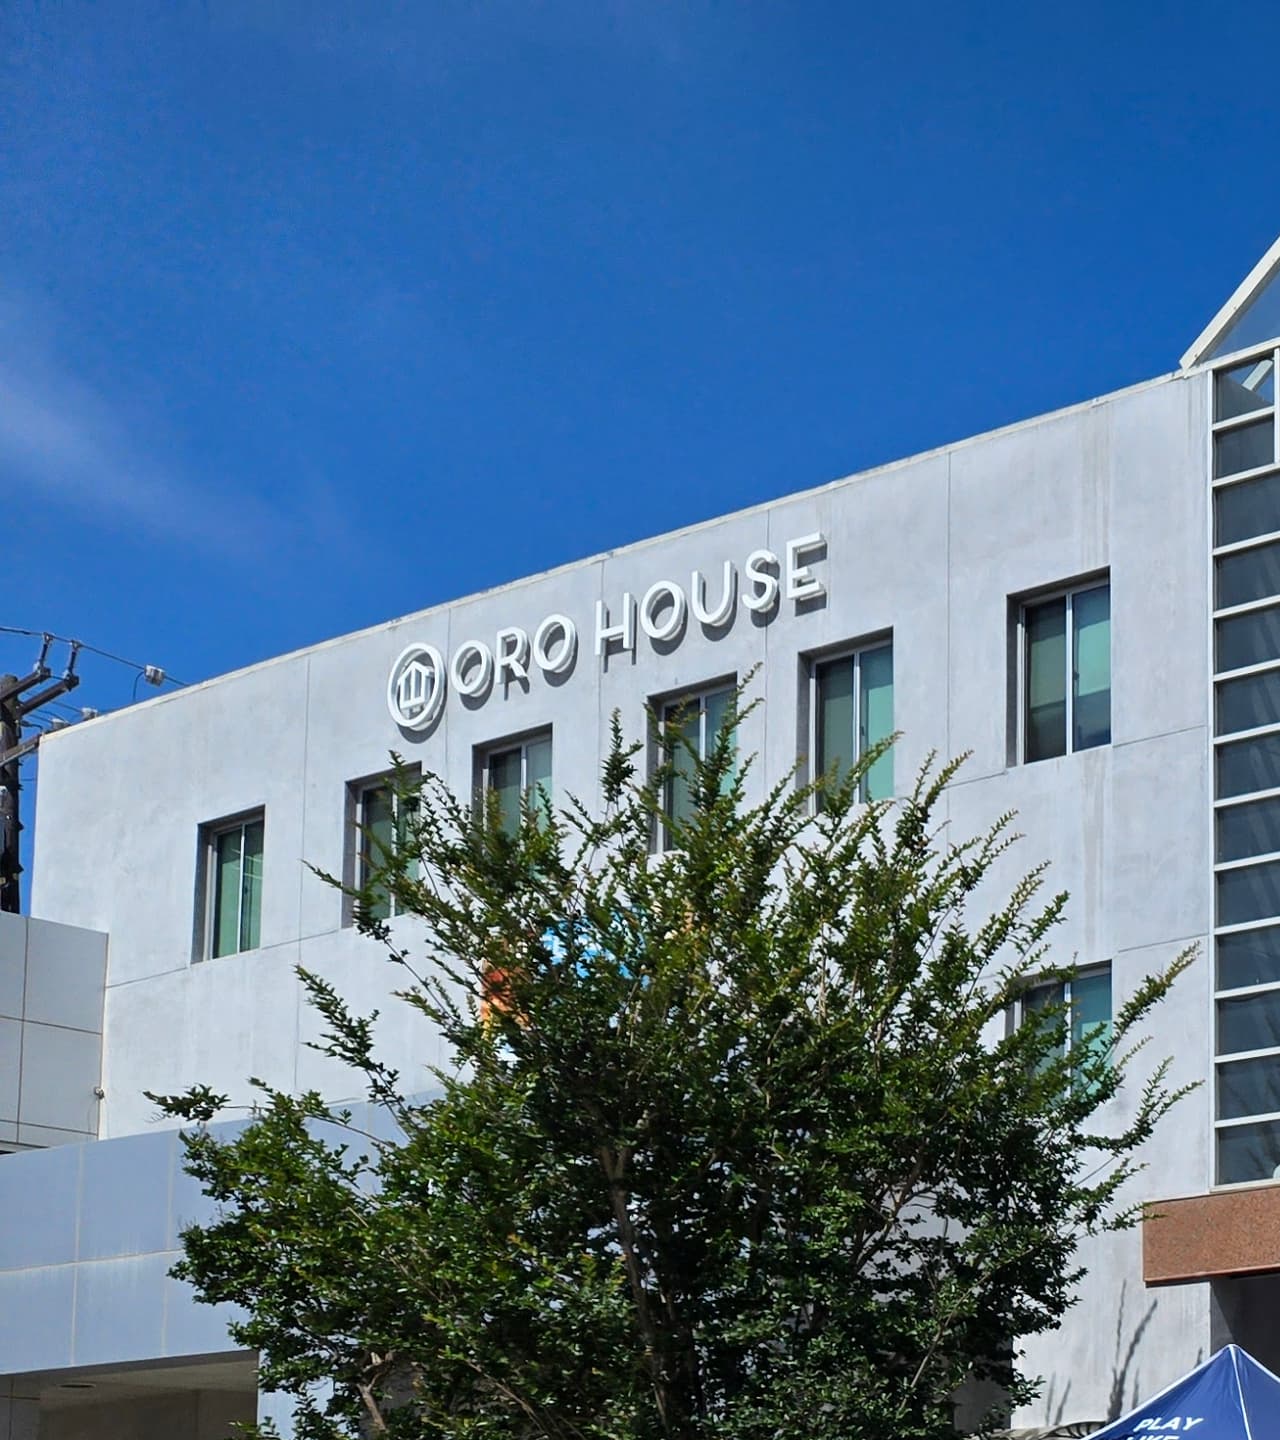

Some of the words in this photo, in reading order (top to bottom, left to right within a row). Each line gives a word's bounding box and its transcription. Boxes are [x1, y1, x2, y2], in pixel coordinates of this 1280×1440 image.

[451, 614, 577, 698] ORO
[594, 531, 827, 656] HOUSE
[1133, 1416, 1204, 1432] PLAY
